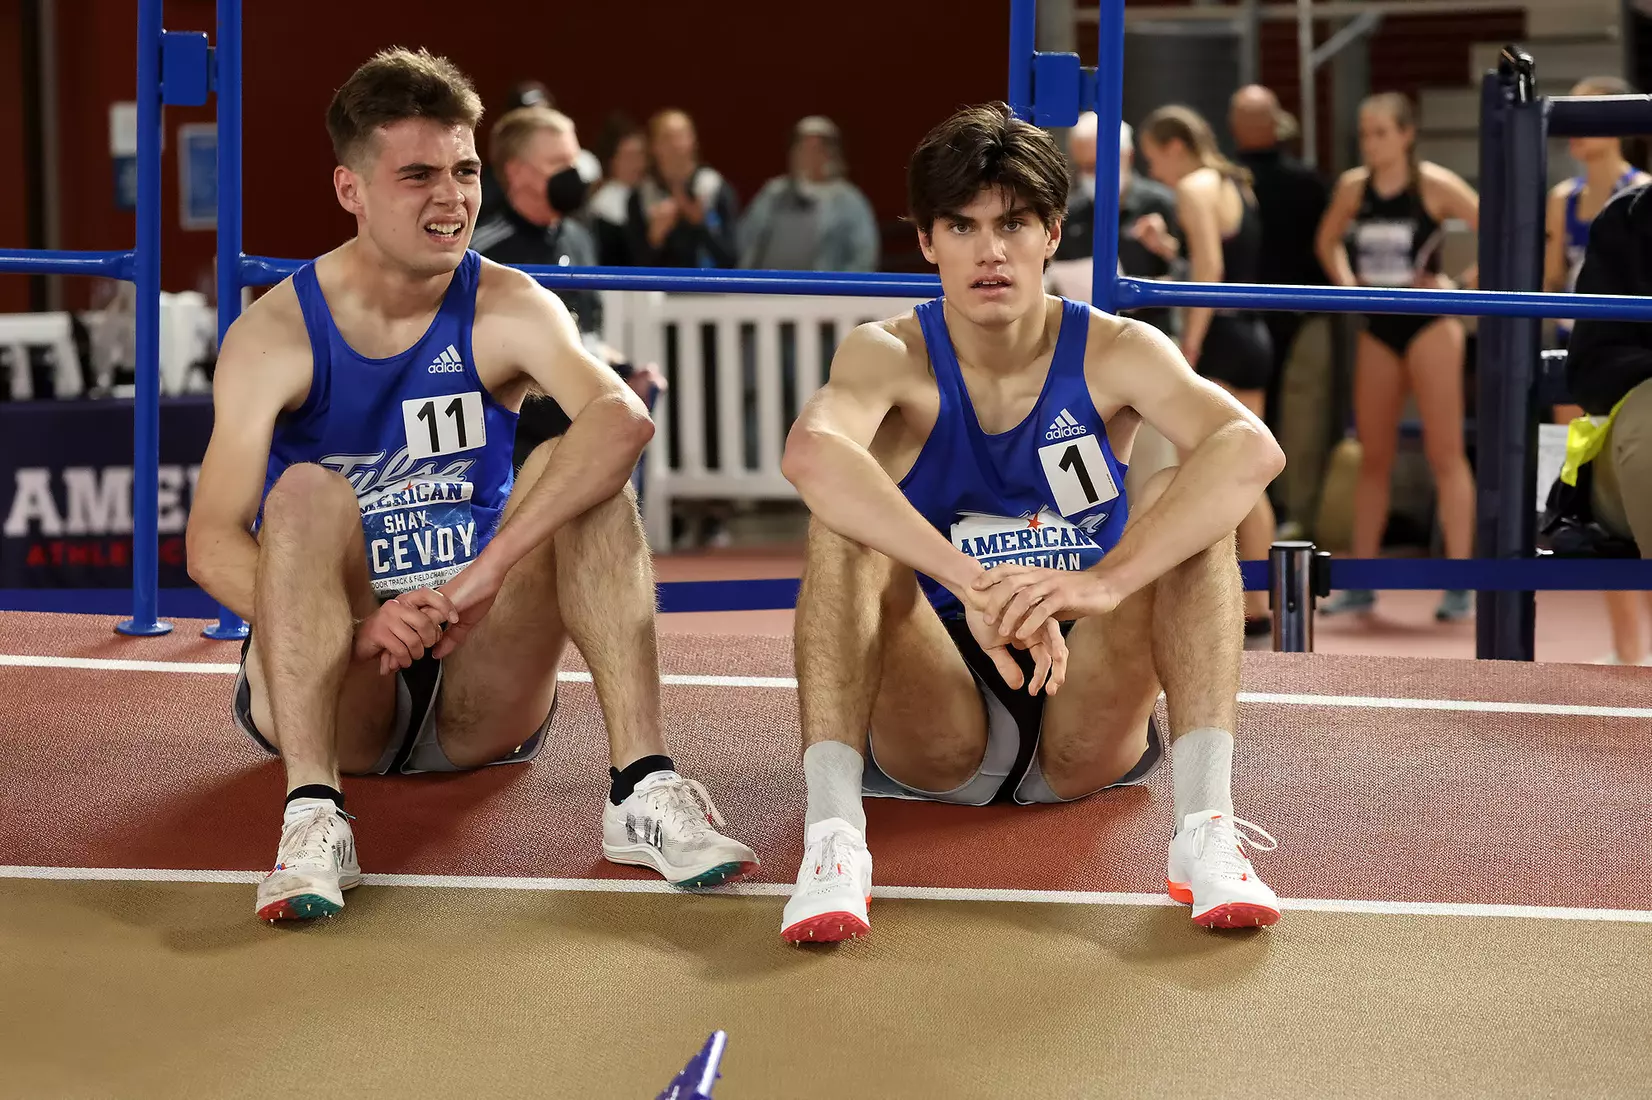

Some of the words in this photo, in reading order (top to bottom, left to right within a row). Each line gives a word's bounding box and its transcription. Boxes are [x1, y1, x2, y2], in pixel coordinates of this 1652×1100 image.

[428, 362, 465, 374] adida
[416, 397, 468, 453] 11
[1045, 423, 1087, 440] adidas
[1058, 444, 1100, 504] 1
[3, 467, 202, 537] AME
[383, 510, 427, 534] SHAY
[960, 526, 1093, 558] AMERICAN
[389, 576, 409, 587] TRACK
[413, 573, 430, 582] FIELD
